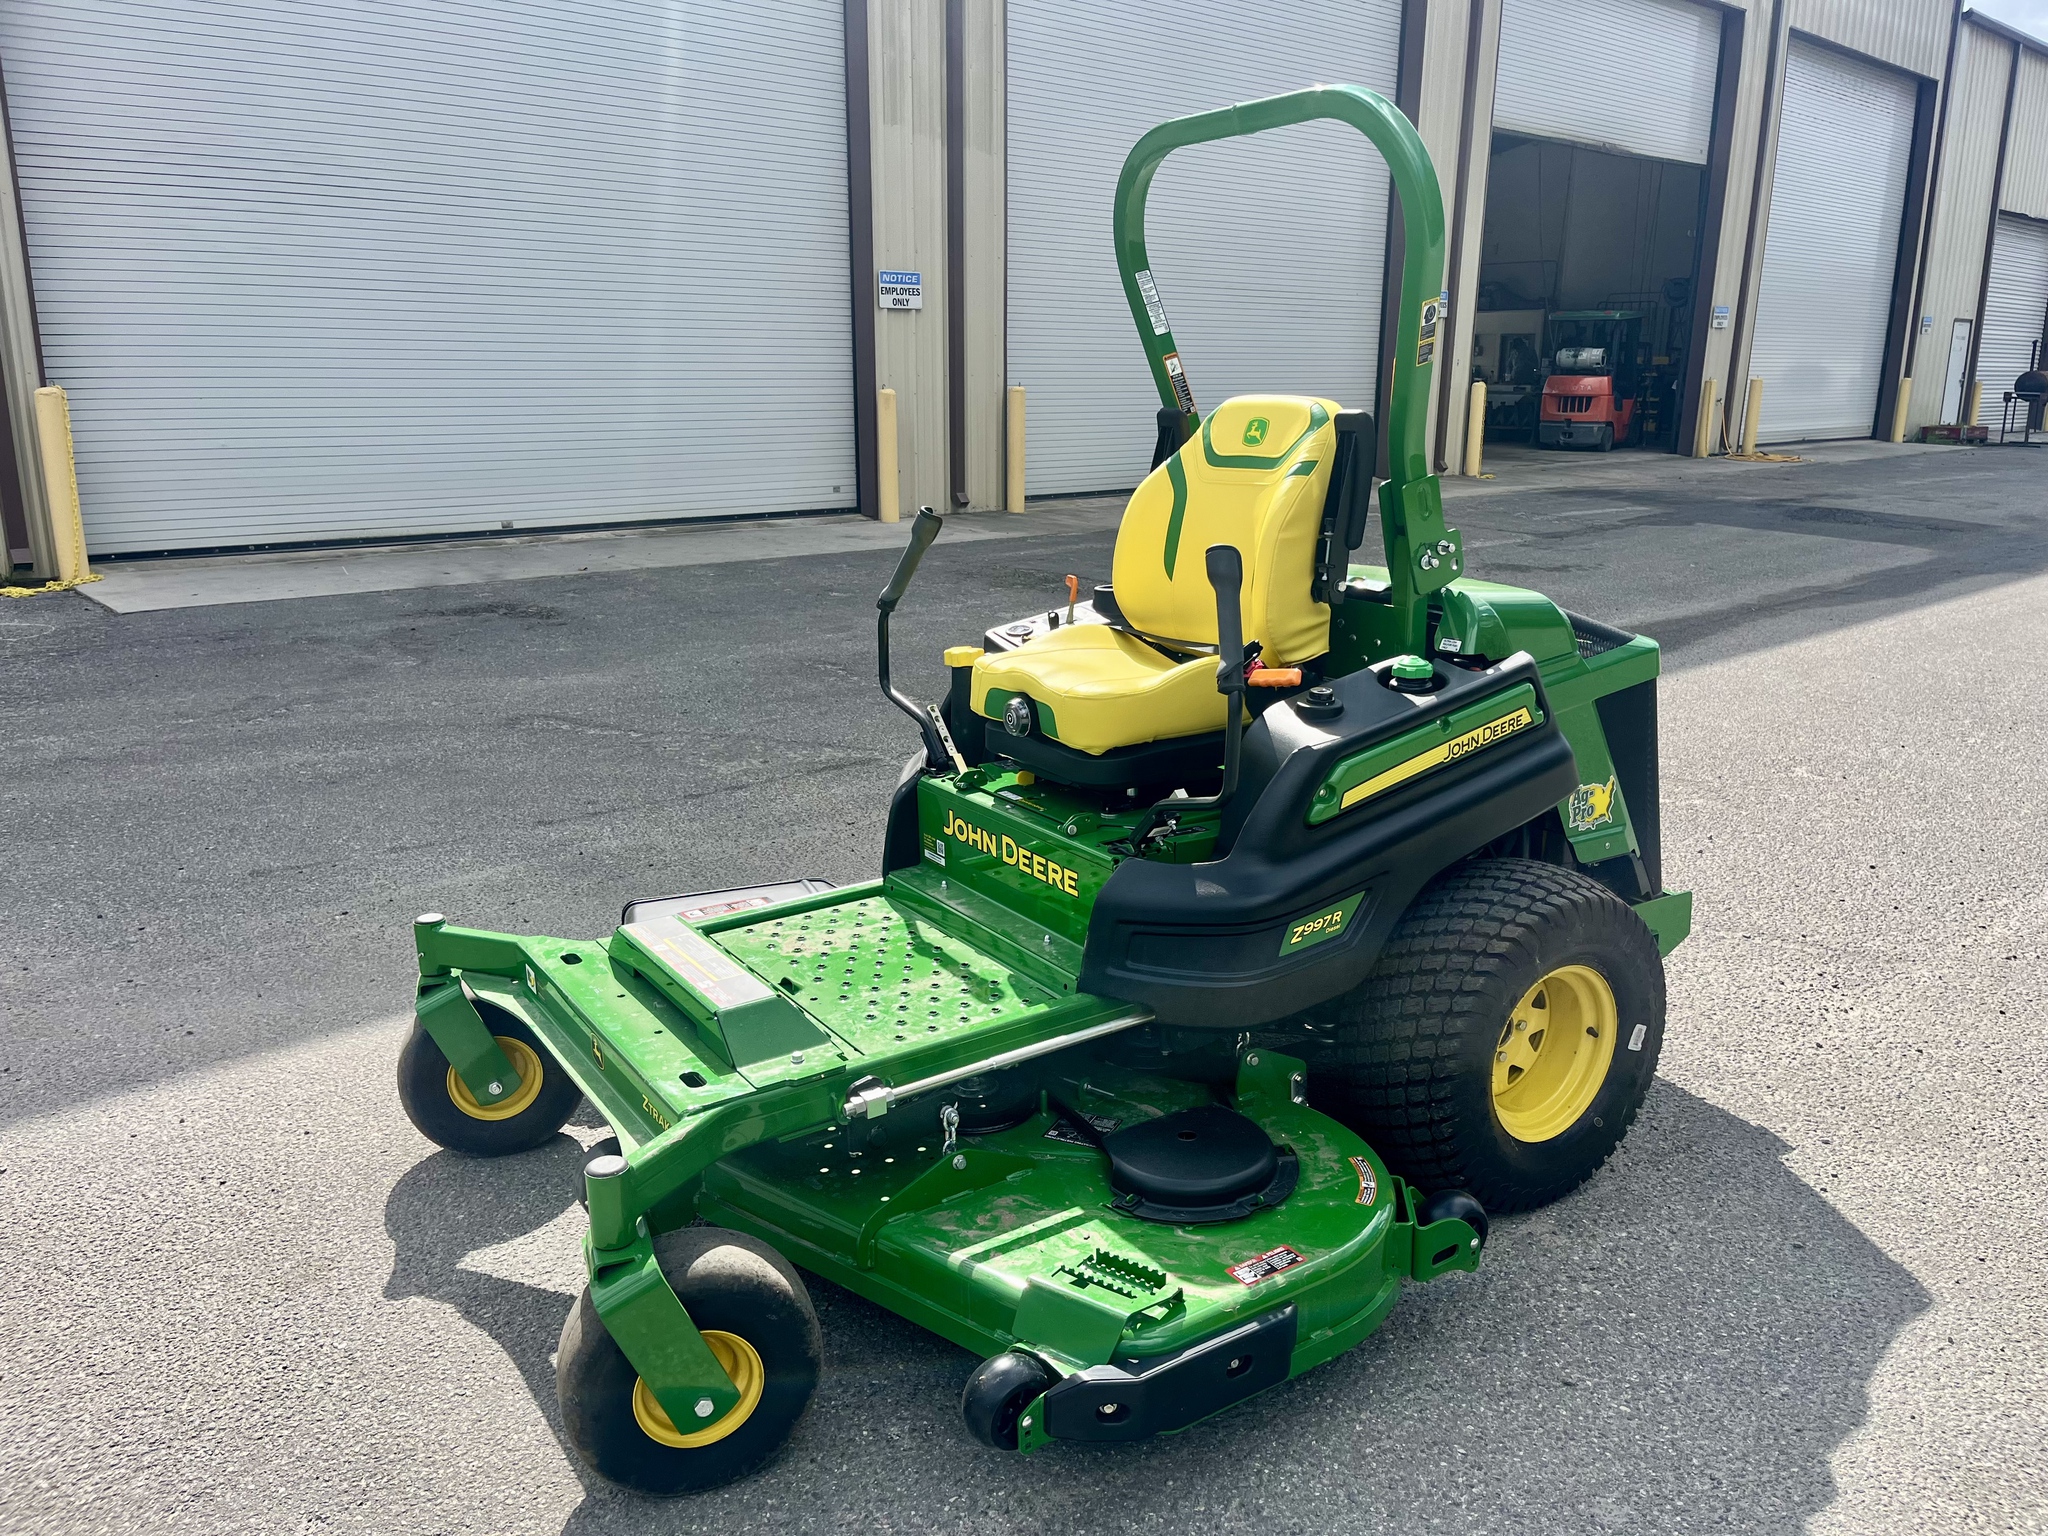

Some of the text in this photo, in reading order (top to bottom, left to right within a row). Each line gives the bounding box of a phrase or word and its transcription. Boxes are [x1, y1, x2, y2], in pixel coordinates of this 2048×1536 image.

[880, 286, 921, 297] EMPLOYEES
[882, 273, 918, 283] NOTICE
[892, 298, 910, 307] ONLY
[1443, 713, 1523, 761] JOHN DEERE
[1572, 804, 1595, 824] Pro
[943, 808, 997, 859] JOHN
[1001, 833, 1080, 899] DEERE
[1290, 909, 1343, 945] Z997R
[642, 1093, 670, 1131] ZTRAK
